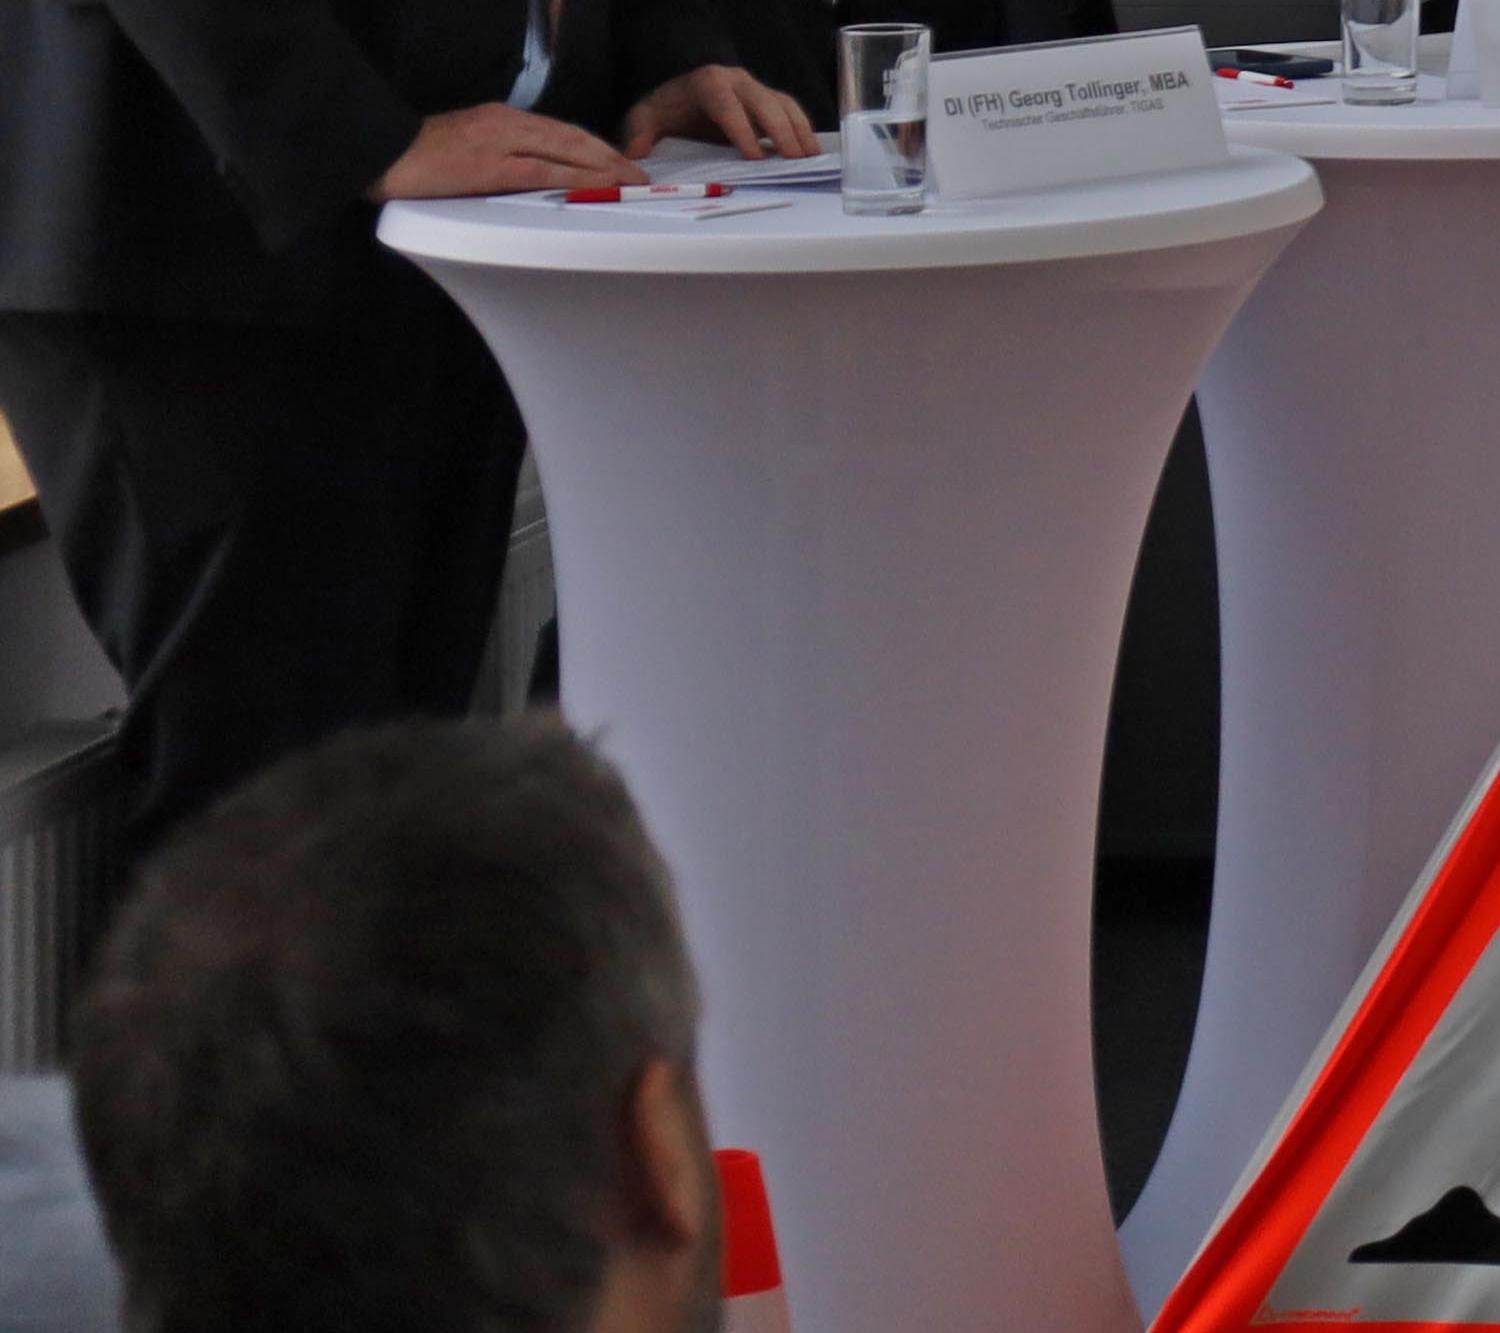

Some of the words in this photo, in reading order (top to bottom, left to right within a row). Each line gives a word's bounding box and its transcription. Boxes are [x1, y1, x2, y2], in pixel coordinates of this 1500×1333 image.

[944, 97, 964, 117] DI
[968, 93, 1005, 118] (FH)
[1008, 89, 1063, 109] Georg
[1067, 79, 1146, 102] Tollinger,
[1149, 71, 1190, 92] MBA
